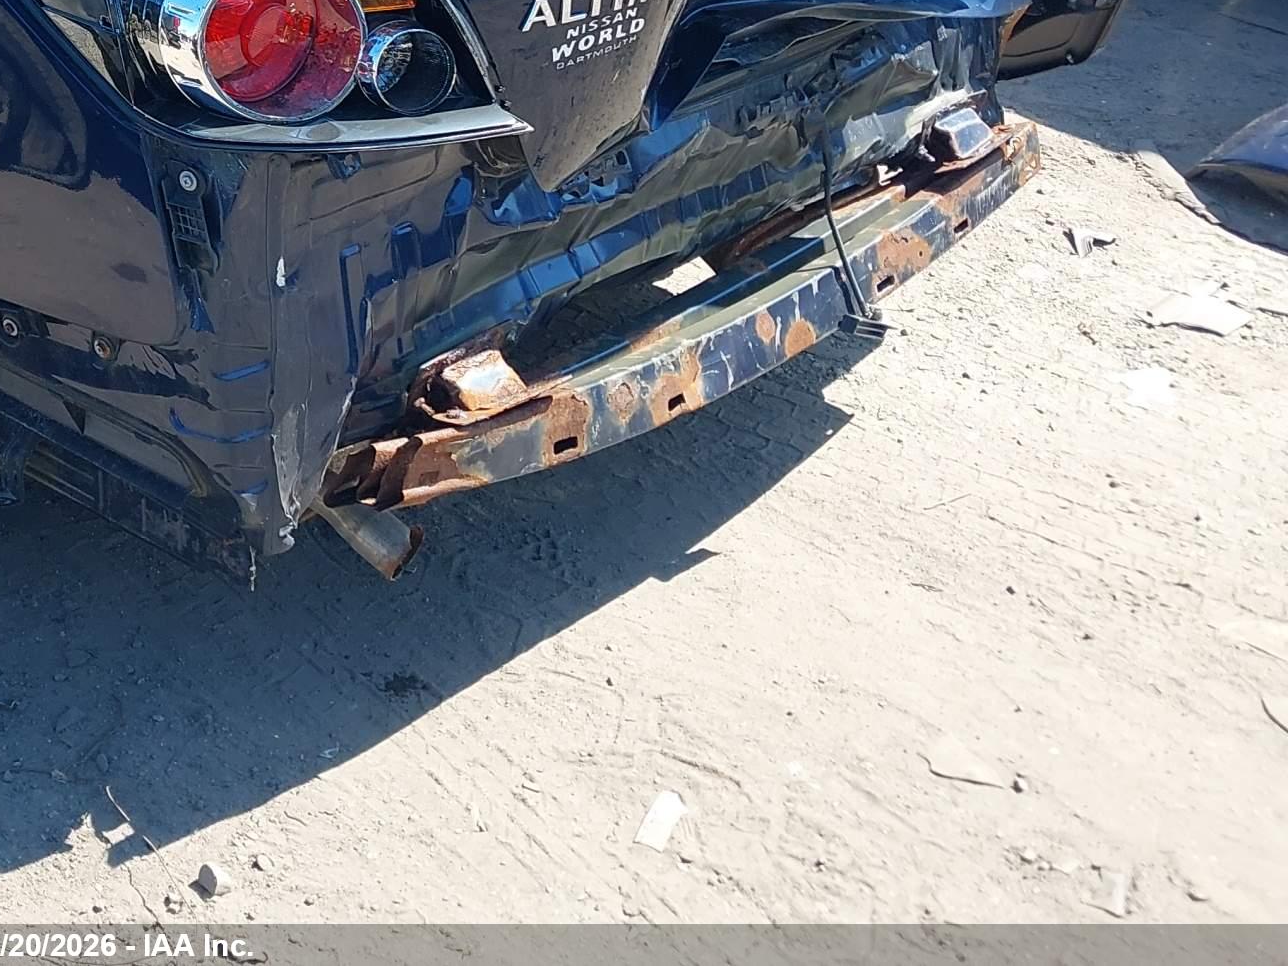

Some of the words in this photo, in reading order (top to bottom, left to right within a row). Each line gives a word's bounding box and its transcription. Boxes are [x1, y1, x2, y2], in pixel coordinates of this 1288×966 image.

[551, 18, 645, 63] WORLD
[566, 7, 638, 39] NISSAN
[556, 35, 638, 70] DARTMOUTH
